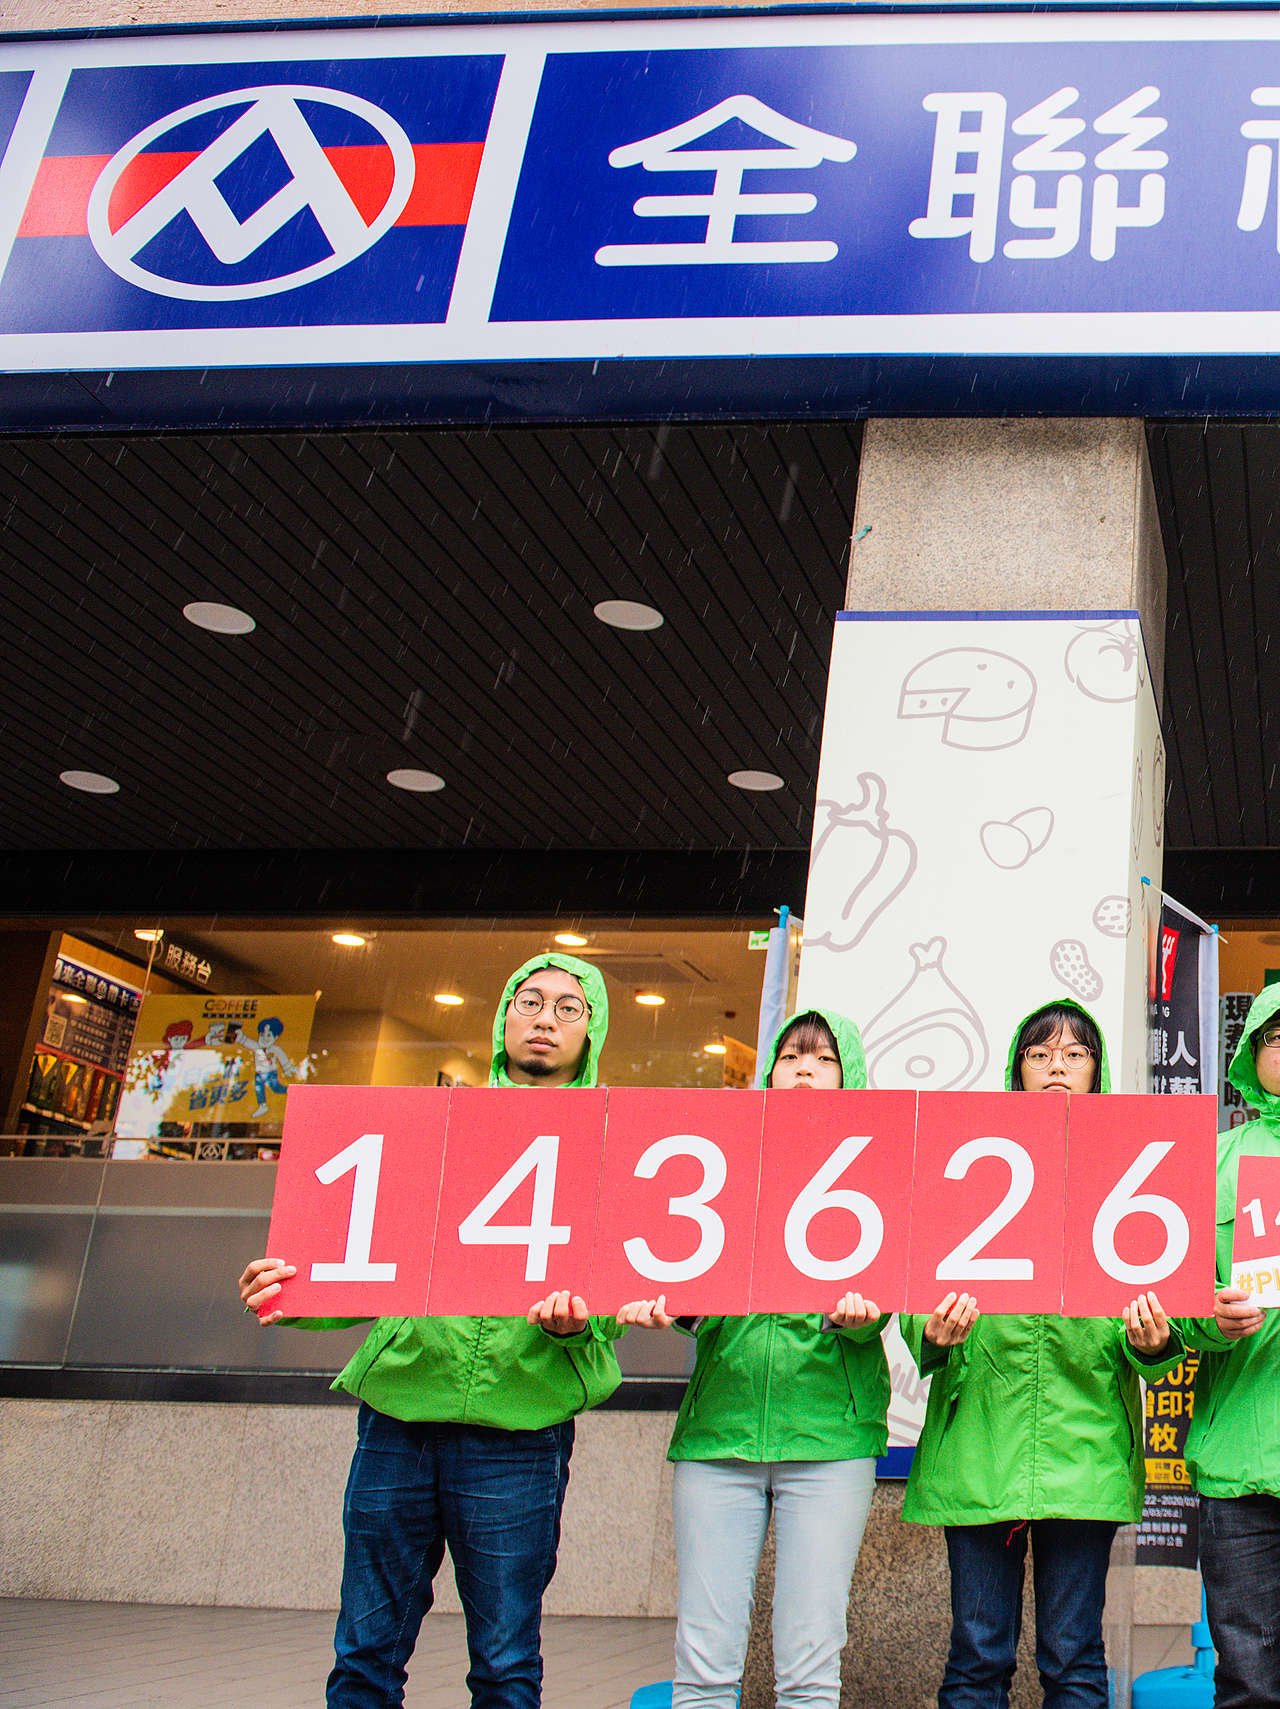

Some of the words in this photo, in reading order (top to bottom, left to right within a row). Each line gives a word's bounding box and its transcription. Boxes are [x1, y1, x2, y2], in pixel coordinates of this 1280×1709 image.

[165, 944, 212, 984] 服務台
[204, 1000, 259, 1012] COFFEE
[1149, 1422, 1178, 1453] 枚
